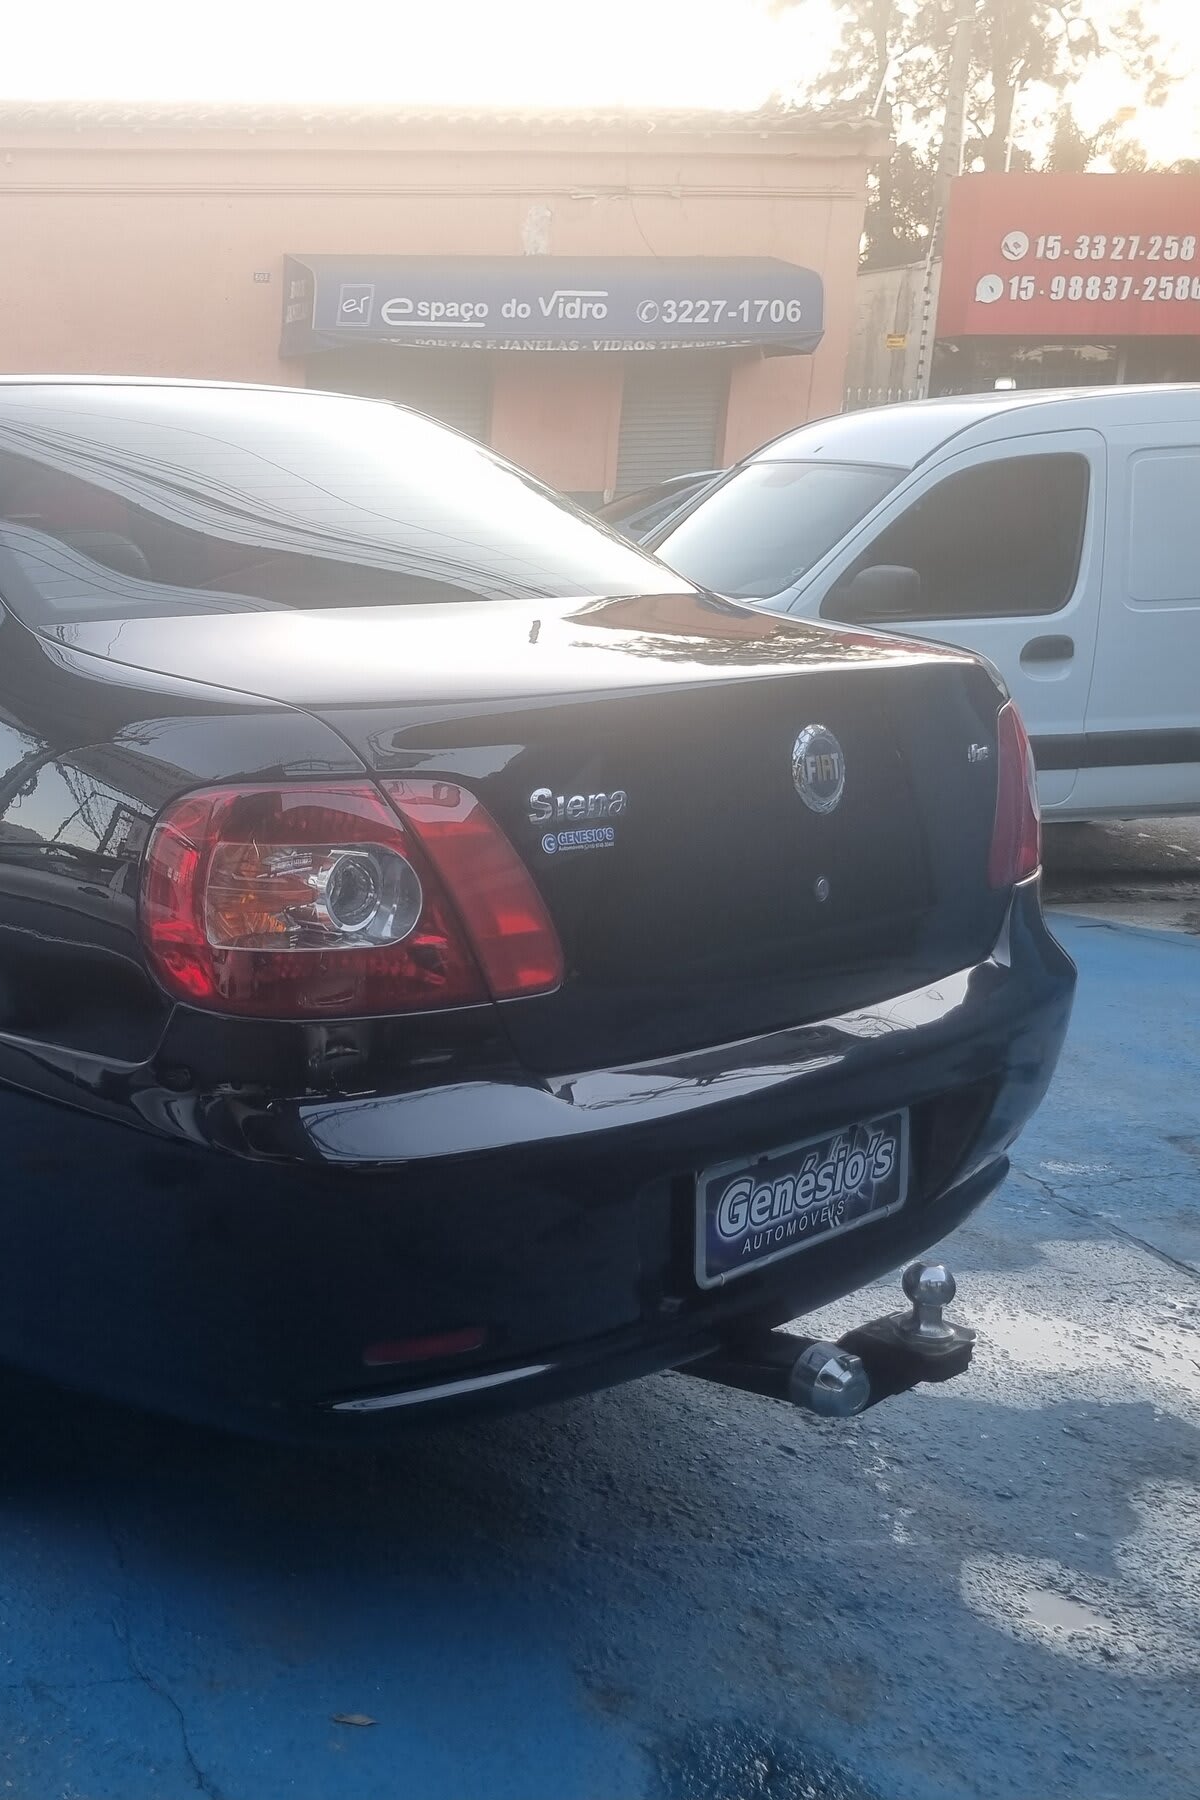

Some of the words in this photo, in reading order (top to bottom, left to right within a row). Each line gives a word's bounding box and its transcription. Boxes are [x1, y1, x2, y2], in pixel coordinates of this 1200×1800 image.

[381, 297, 489, 327] espaço
[501, 298, 531, 319] do
[538, 290, 608, 320] Vidro
[661, 299, 802, 323] 3227-1706
[500, 339, 579, 351] JANELAS
[591, 339, 656, 351] VIDROS
[805, 752, 839, 784] FIAT
[529, 788, 628, 823] Siena
[719, 1132, 896, 1239] Genésio's
[742, 1200, 846, 1254] AUTOMÓVEIS
